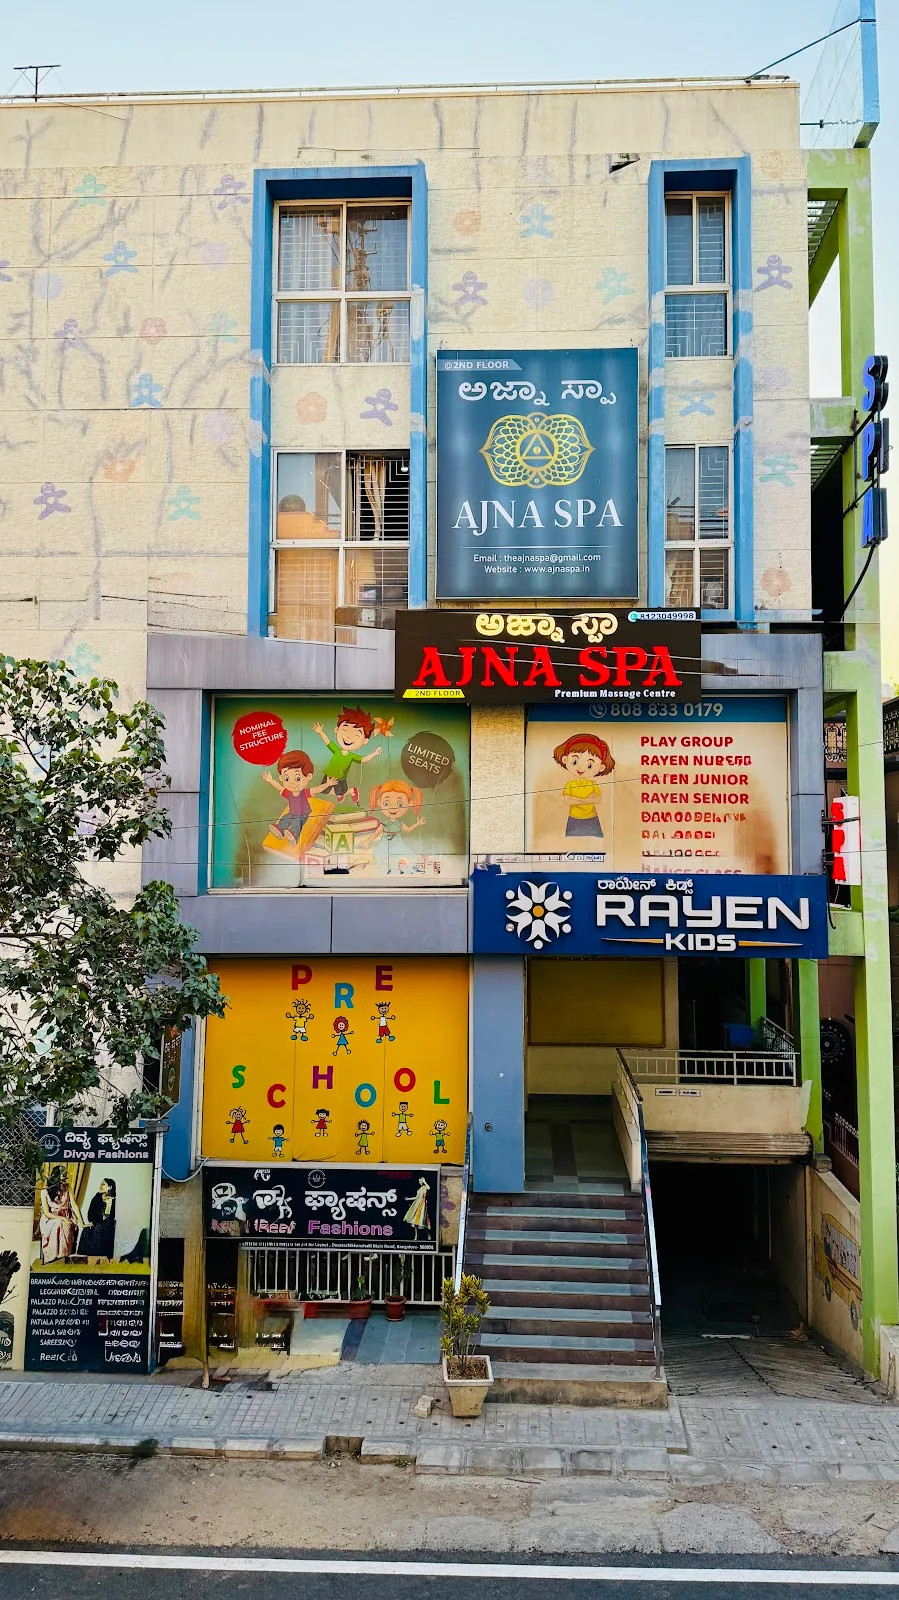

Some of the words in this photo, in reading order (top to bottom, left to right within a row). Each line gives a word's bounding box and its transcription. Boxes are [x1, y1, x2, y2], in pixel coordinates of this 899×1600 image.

[444, 361, 473, 370] @2ND
[476, 361, 509, 369] FLOOR
[451, 499, 546, 536] AJNA
[554, 497, 624, 528] SPA
[473, 553, 498, 562] Email
[504, 553, 601, 563] theajnaspa@gmail.com
[484, 565, 518, 573] Website
[524, 565, 590, 574] www.ajnaspa.in
[412, 646, 562, 688] AJNA
[578, 645, 683, 688] SPA
[554, 689, 598, 698] Premium
[600, 689, 641, 699] Massage
[643, 689, 676, 698] Centre
[610, 703, 643, 717] 808
[647, 703, 678, 717] 833
[683, 702, 724, 717] 0179
[239, 719, 277, 736] NOMINAL
[252, 729, 267, 739] FEE
[239, 731, 285, 751] STRUCTURE
[640, 736, 677, 747] PLAY
[680, 736, 734, 748] GROUP
[407, 743, 450, 766] LIMITED
[640, 755, 689, 766] RAYEN
[408, 755, 441, 775] SEATS
[692, 774, 749, 785] JUNIOR
[640, 792, 689, 804] RAYEN
[692, 793, 749, 805] SENIOR
[596, 894, 809, 930] RAYEN
[665, 933, 737, 952] KIDS
[291, 964, 394, 1009] PRE
[231, 1064, 450, 1109] SCHOOL
[63, 1150, 96, 1160] Divya
[98, 1149, 149, 1159] Fashions
[307, 1220, 394, 1236] Fashions
